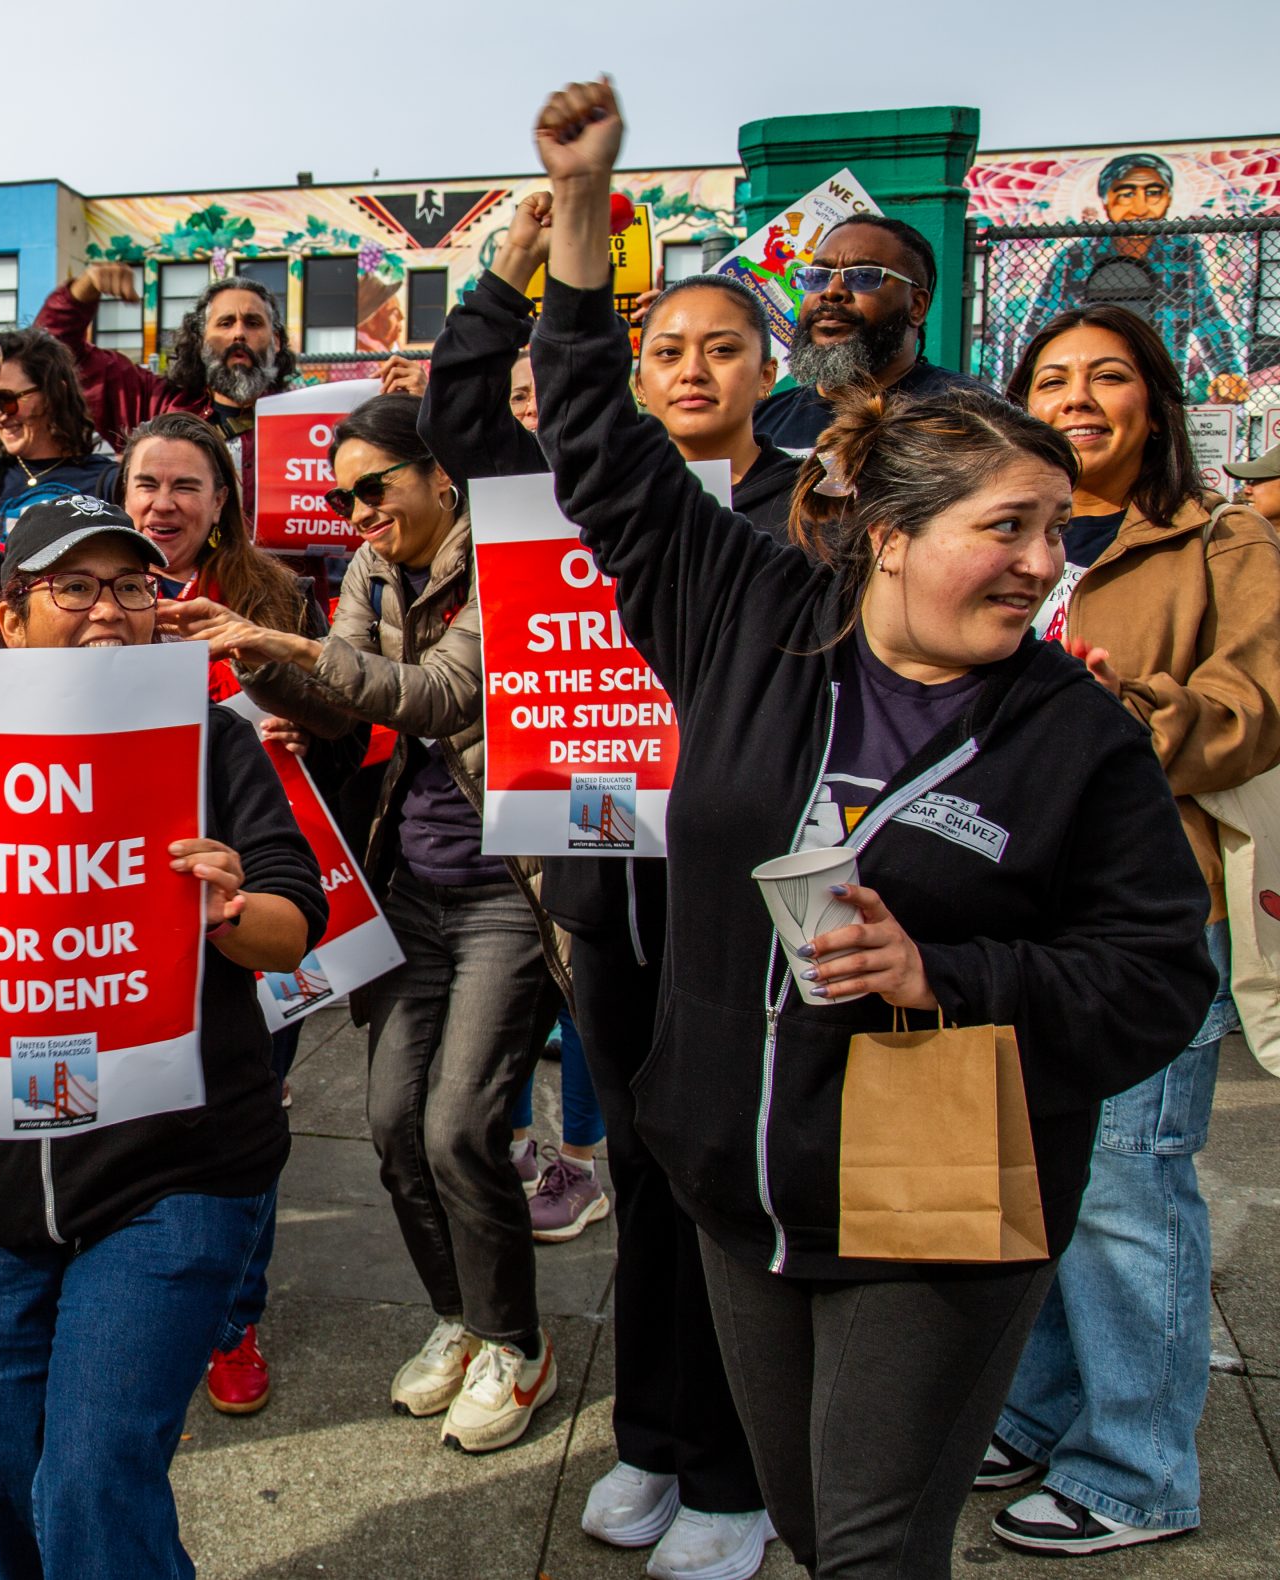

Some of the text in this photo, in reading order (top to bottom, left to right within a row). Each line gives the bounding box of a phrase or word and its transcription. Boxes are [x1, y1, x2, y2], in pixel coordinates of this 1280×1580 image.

[829, 180, 854, 204] WE
[742, 273, 756, 289] FOR
[767, 302, 796, 335] SCHOOLS
[769, 320, 794, 347] DESER
[309, 424, 338, 447] O
[290, 494, 328, 512] FOR
[560, 549, 614, 588] O
[489, 671, 541, 695] FOR
[545, 669, 593, 693] THE
[511, 702, 677, 730] OUR STUDEN
[549, 739, 661, 764] DESERVE
[4, 762, 94, 815] ON
[959, 803, 970, 812] 25
[945, 813, 998, 845] CHÁVEZ
[52, 920, 139, 961] OUR
[16, 1038, 93, 1050] UNITED EDUCATORS
[30, 1050, 46, 1059] SAN
[48, 1047, 91, 1058] FRANCISCO
